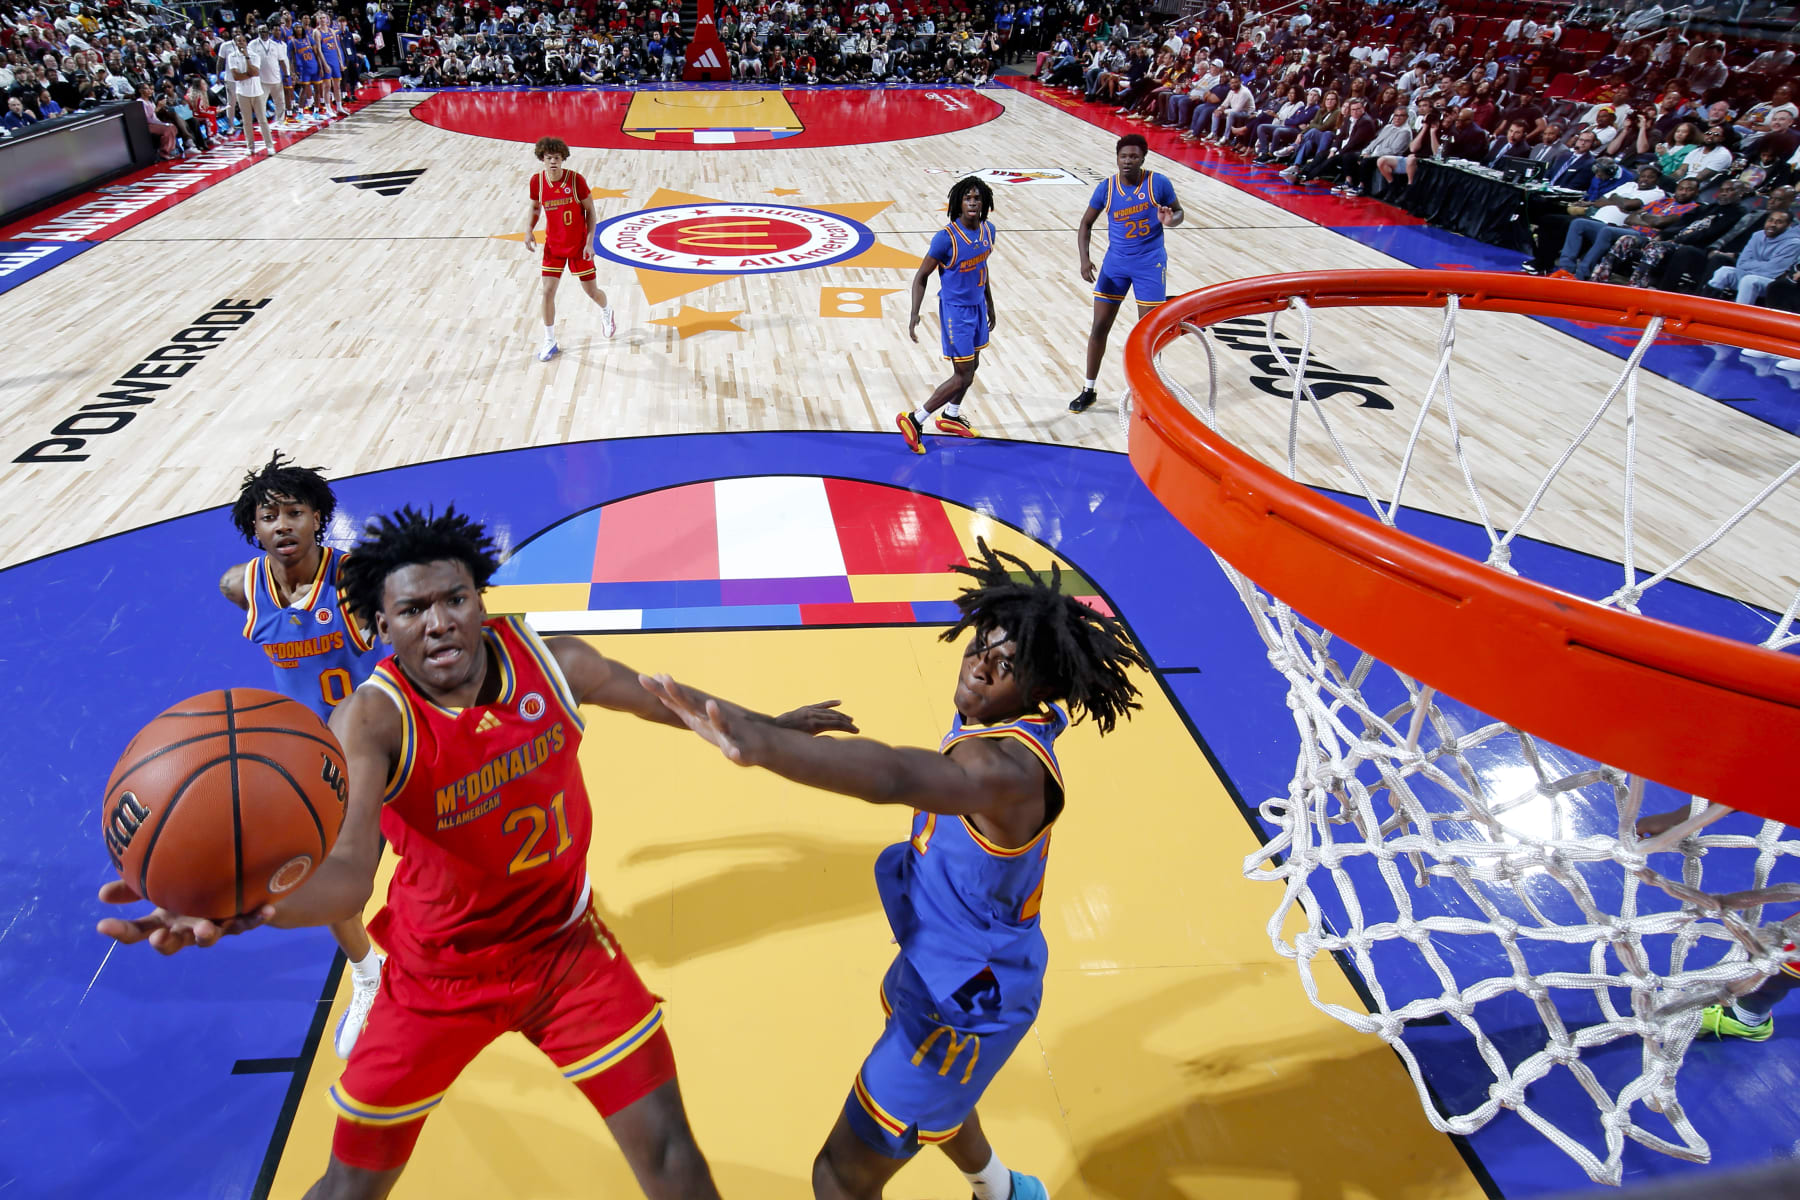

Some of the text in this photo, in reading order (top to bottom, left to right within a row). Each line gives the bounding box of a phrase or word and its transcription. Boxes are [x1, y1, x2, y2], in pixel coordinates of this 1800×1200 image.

[10, 173, 212, 241] AMERICAN
[563, 210, 572, 226] 0
[616, 207, 849, 267] McDonald's All American Games
[1124, 219, 1151, 239] 25
[0, 246, 63, 276] LL
[11, 298, 273, 463] POWERADE
[1185, 310, 1395, 410] Spri
[319, 667, 354, 707] 0
[435, 722, 565, 817] McDONALD'S
[437, 792, 501, 831] ALL AMERICAN
[501, 789, 573, 876] 21
